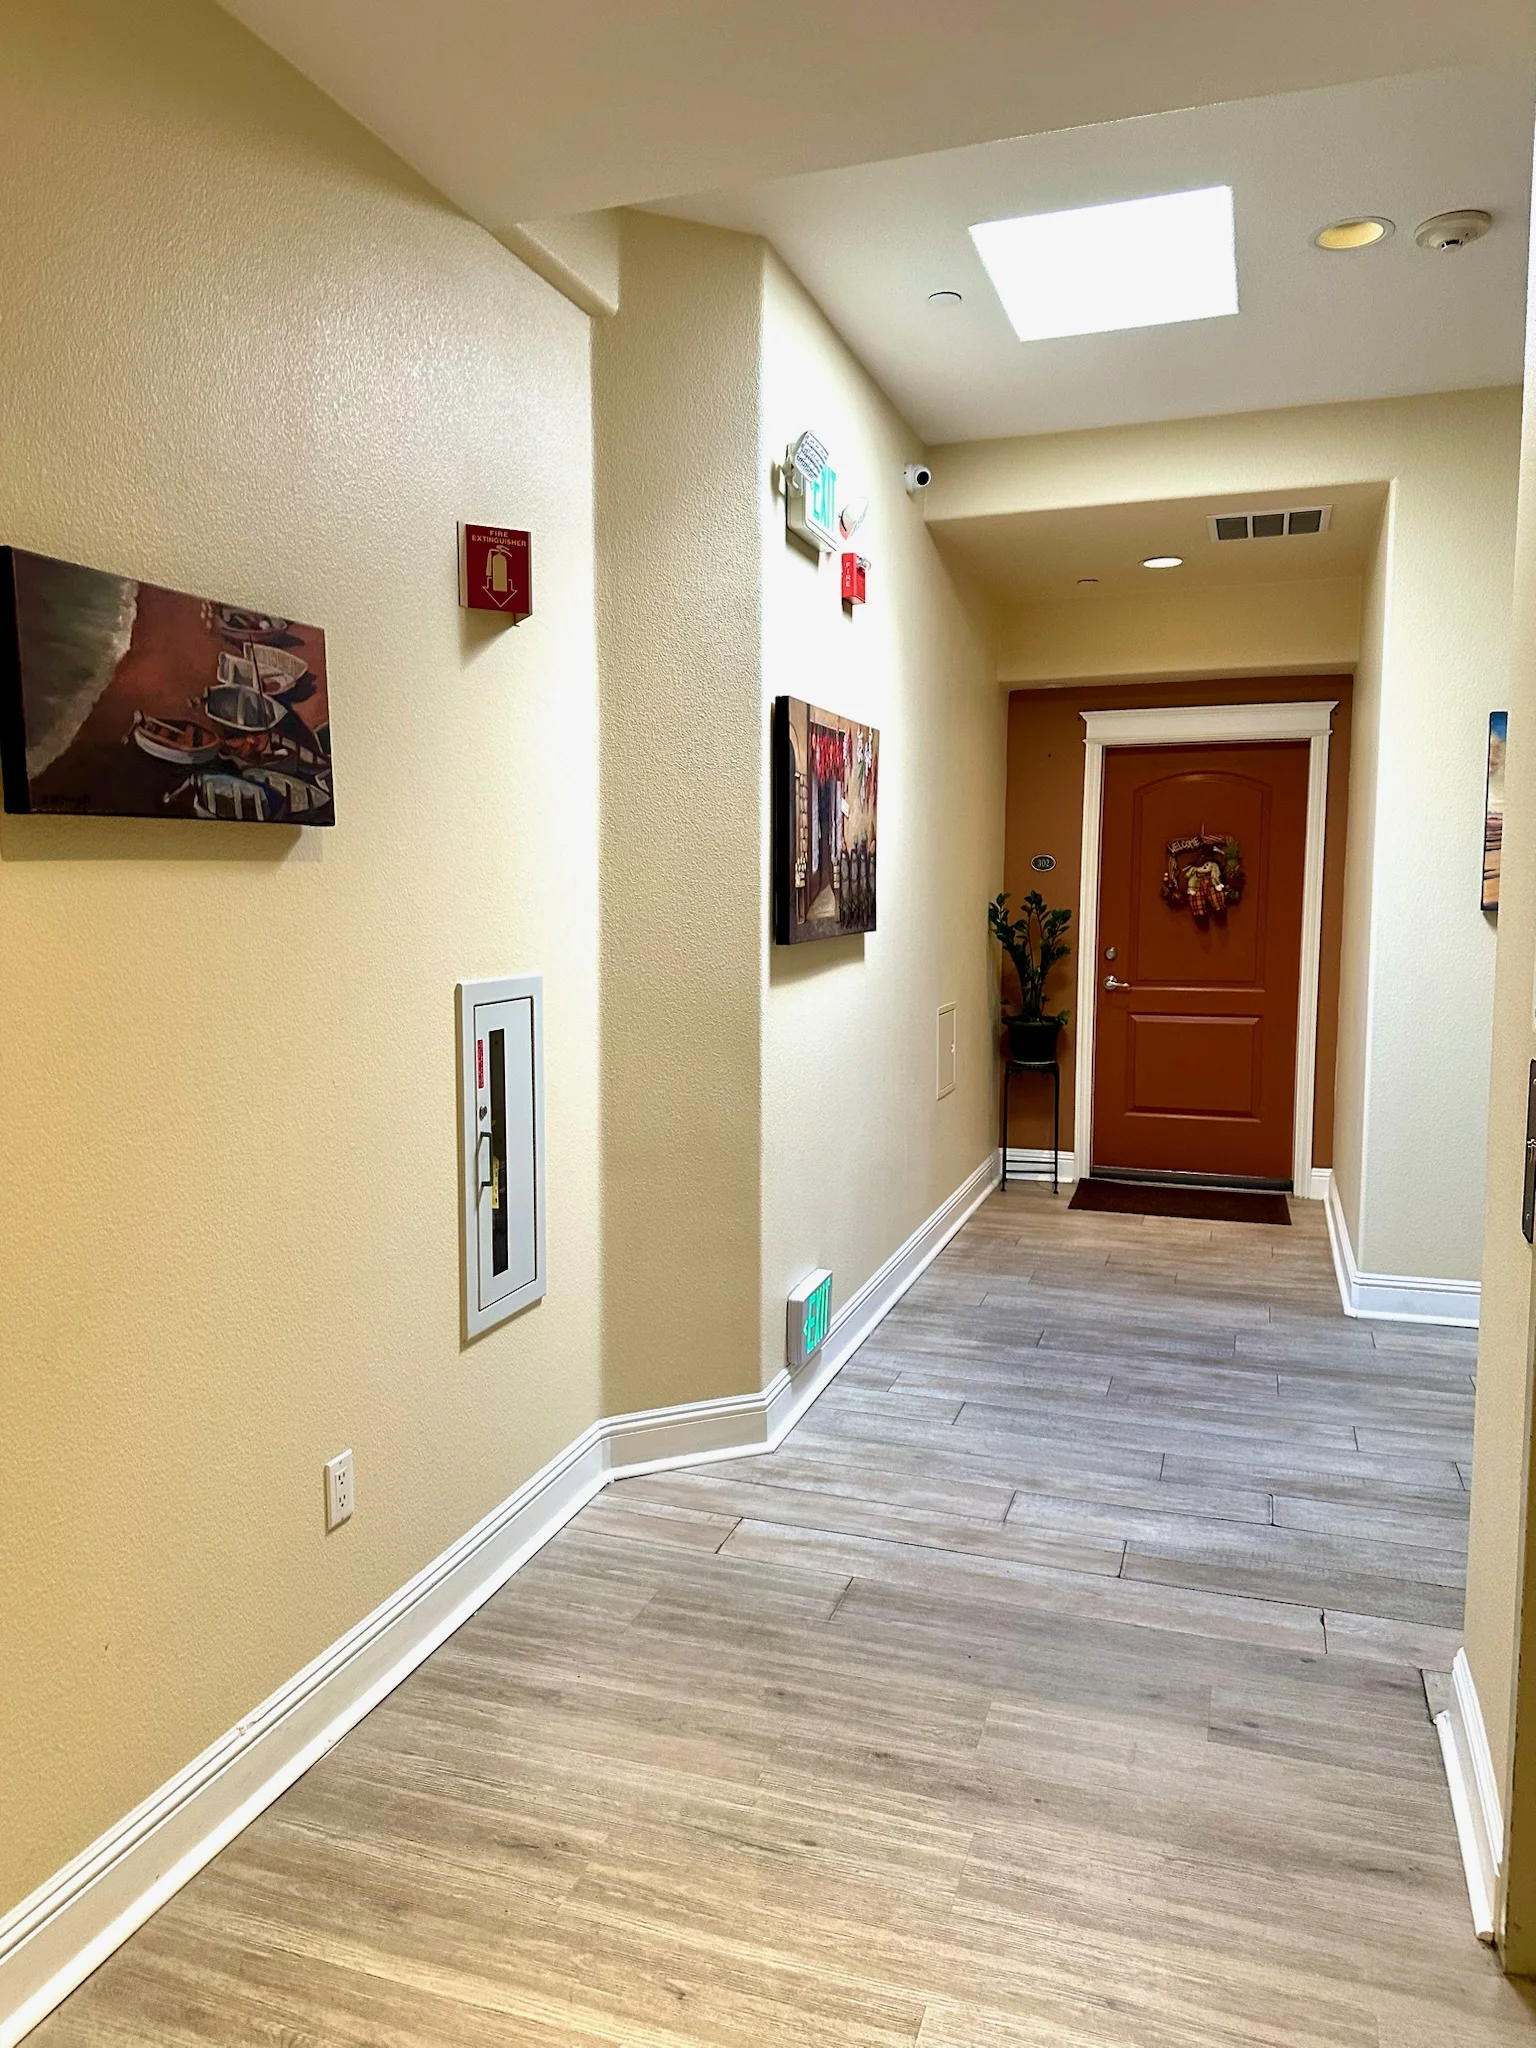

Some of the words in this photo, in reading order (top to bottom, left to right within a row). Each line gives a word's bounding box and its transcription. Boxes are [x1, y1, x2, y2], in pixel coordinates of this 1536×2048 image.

[471, 534, 527, 547] EXTINGUISHER
[489, 530, 509, 538] FIRE
[1167, 836, 1201, 853] WELCOME
[806, 1277, 831, 1354] EXIT
